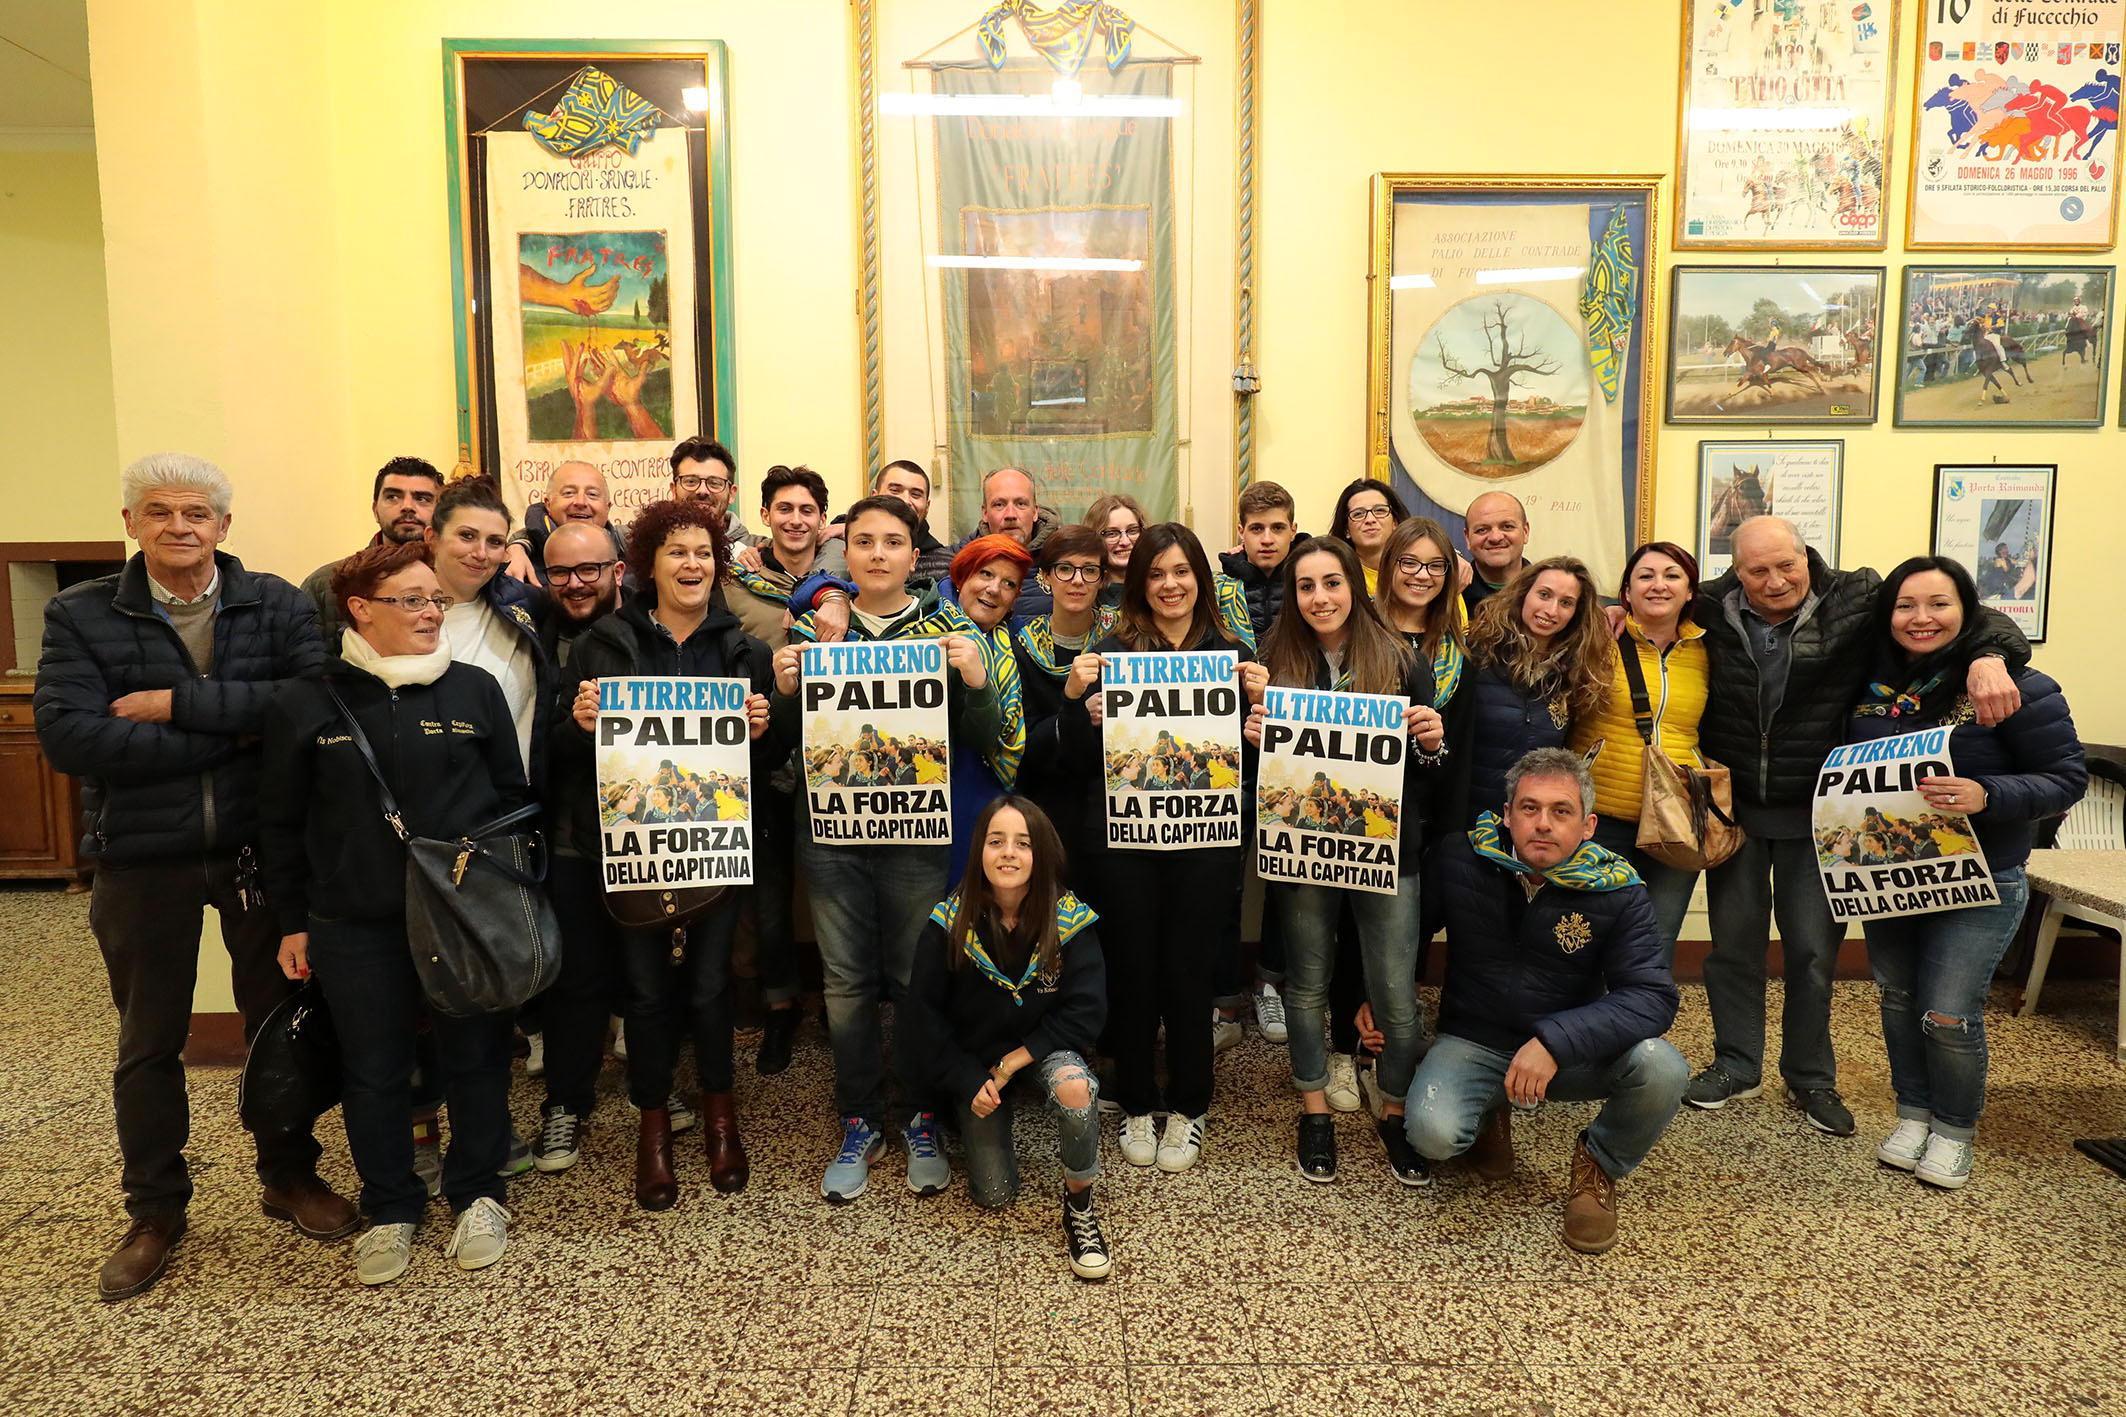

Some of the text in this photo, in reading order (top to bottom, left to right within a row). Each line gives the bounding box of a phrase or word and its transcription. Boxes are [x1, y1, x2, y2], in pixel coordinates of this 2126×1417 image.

[1992, 7, 2098, 29] di Fucecchio
[1957, 166, 2000, 179] DOMENICA
[2005, 167, 2015, 180] 26
[2020, 167, 2053, 180] MAGGIO
[2058, 168, 2078, 180] 1996
[1434, 231, 1517, 244] ASSOCIAZIONE
[1431, 245, 1582, 260] PALIO DELLE CONTRADE
[1431, 267, 1443, 278] DI
[1968, 482, 2045, 494] Porta Raimonda
[1550, 501, 1582, 512] PALIO
[1994, 606, 2034, 614] ITTORIA
[804, 644, 941, 676] IL TIRRENO
[1104, 655, 1233, 684] IL TIRRENO
[600, 681, 744, 711] IL TIRRENO
[806, 678, 943, 711] PALIO
[1106, 688, 1236, 718] PALIO
[1265, 691, 1403, 729] IL TIRRENO
[601, 716, 746, 746] PALIO
[1263, 724, 1402, 766] PALIO
[1824, 730, 1945, 768] IL TIRRENO
[811, 789, 948, 814] LA FORZA
[1109, 794, 1238, 818] LA FORZA
[605, 826, 750, 857] LA FORZA
[813, 817, 949, 839] DELLA CAPITANA
[1110, 821, 1238, 844] DELLA CAPITANA
[1259, 829, 1396, 866] LA FORZA
[607, 856, 750, 885] DELLA CAPITANA
[1259, 853, 1395, 889] DELLA CAPITANA
[1824, 858, 1987, 893] LA FORZA
[1831, 883, 1995, 917] DELLA CAPITANA
